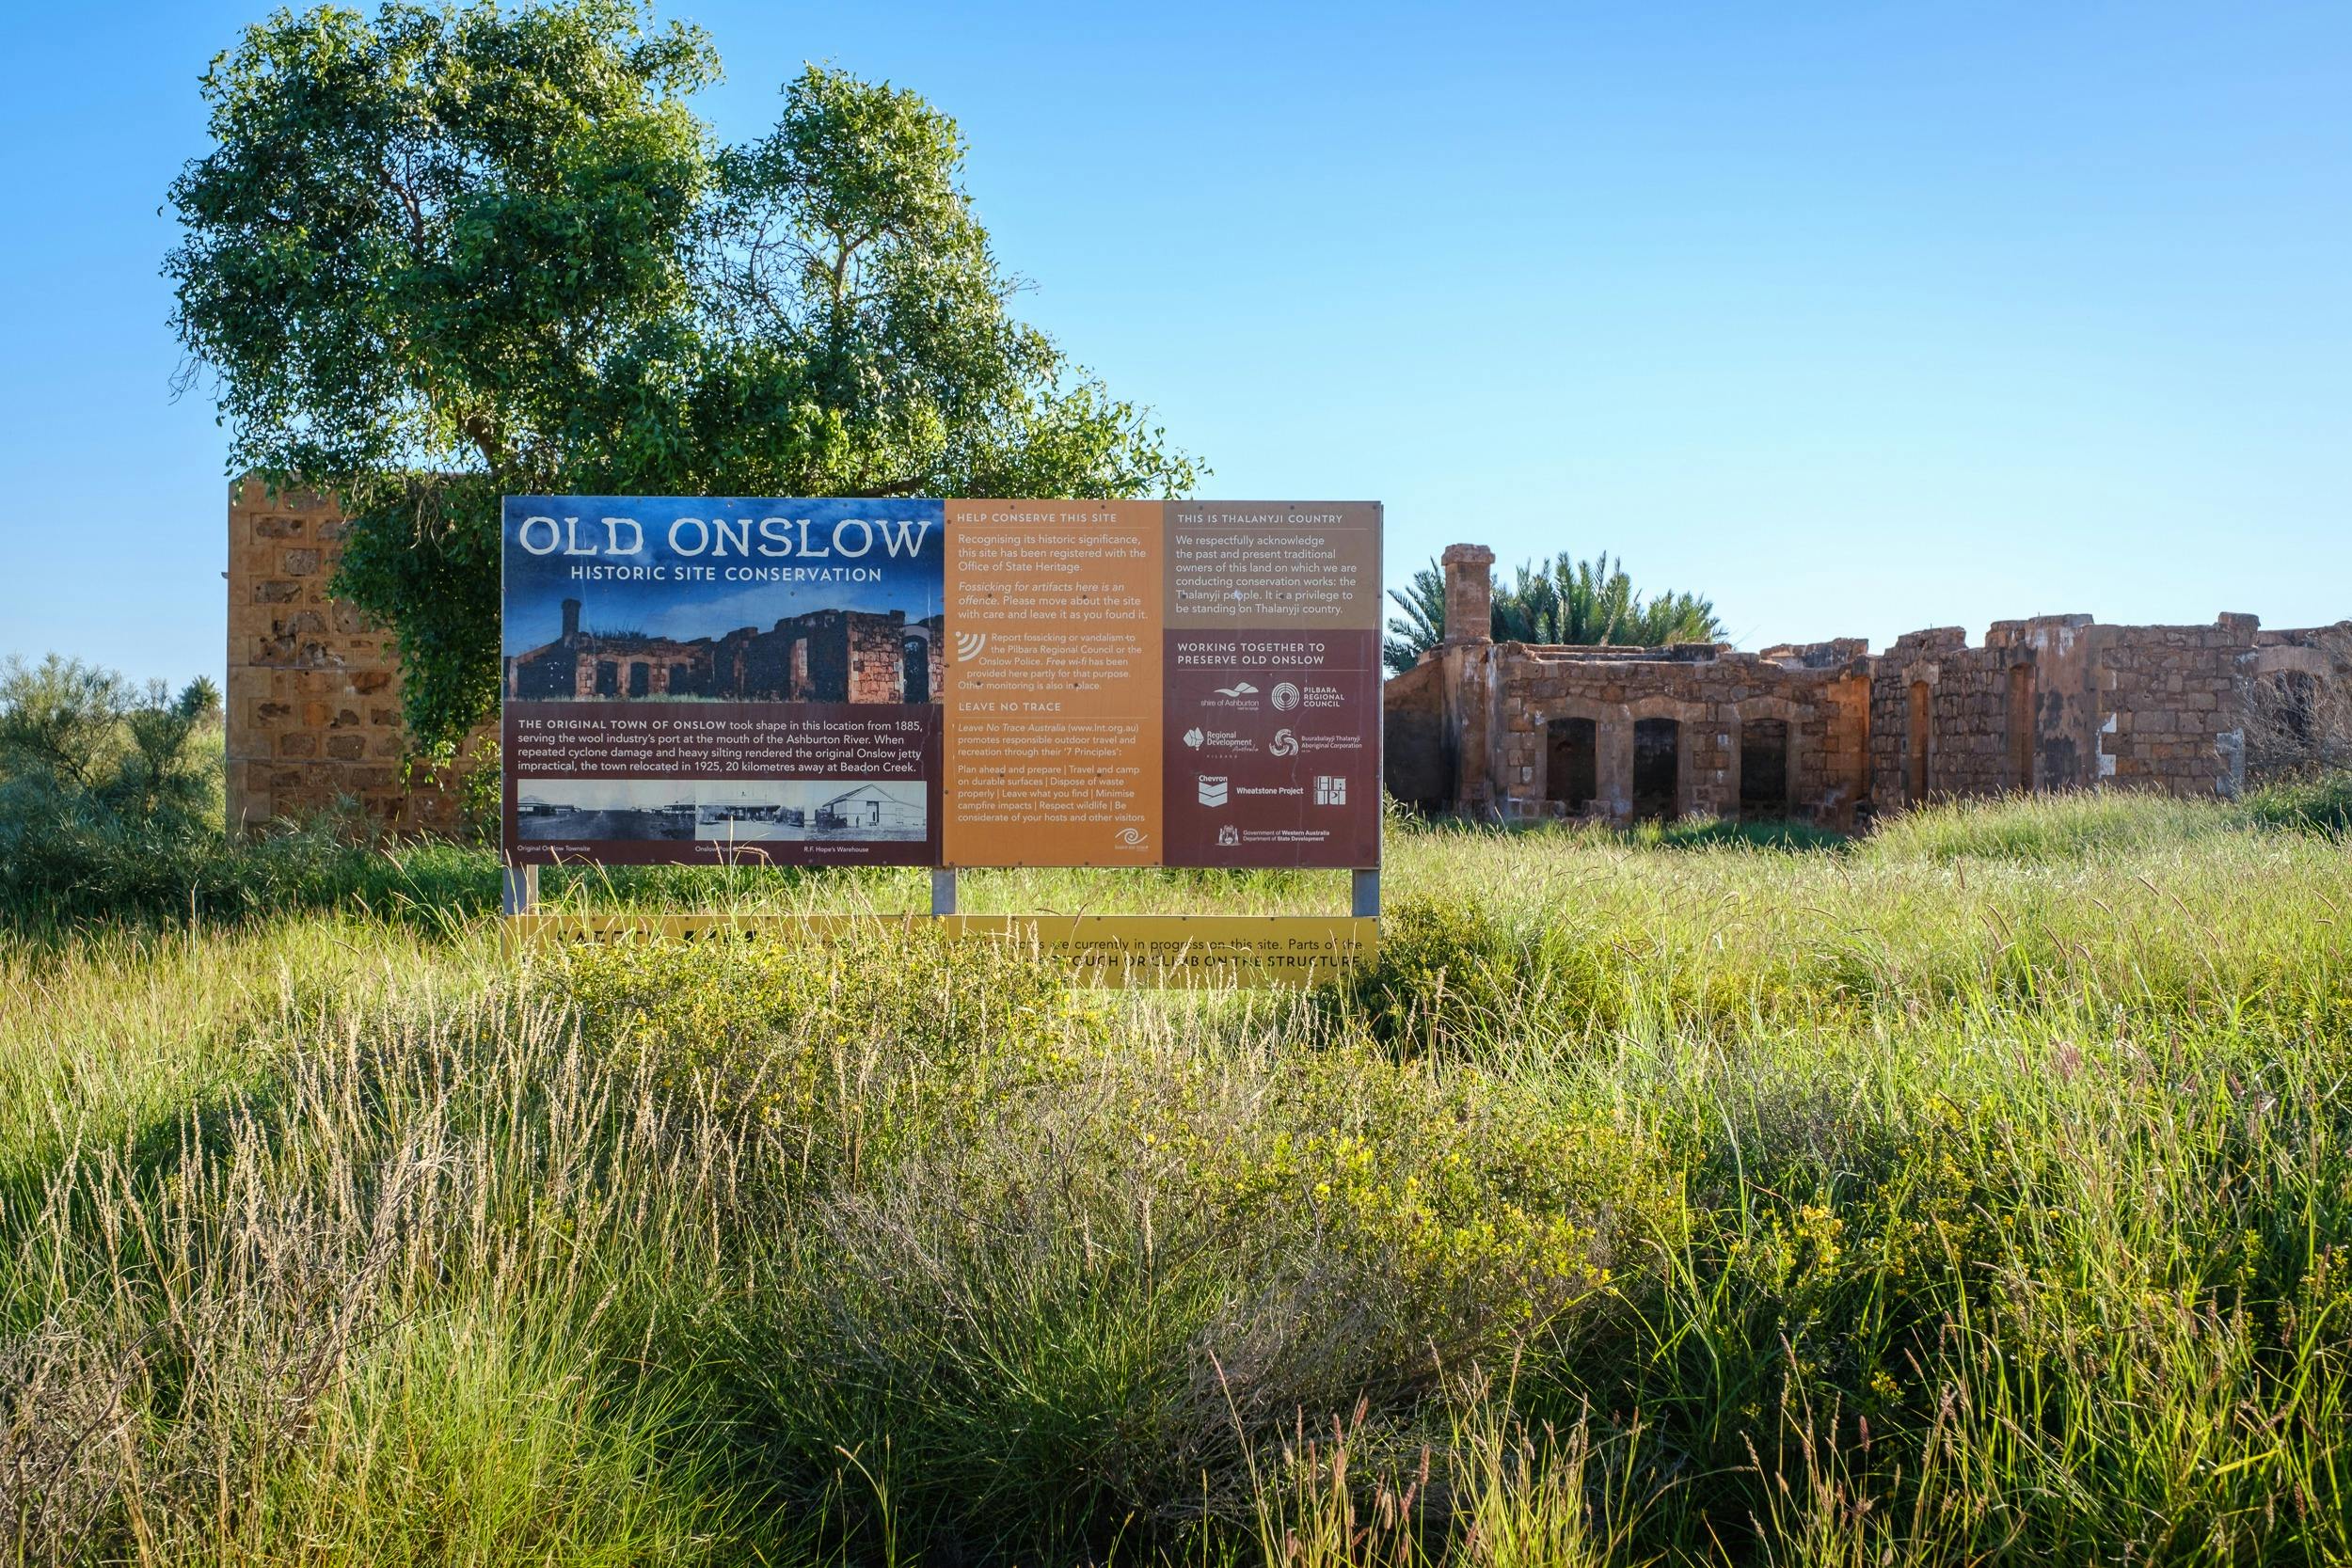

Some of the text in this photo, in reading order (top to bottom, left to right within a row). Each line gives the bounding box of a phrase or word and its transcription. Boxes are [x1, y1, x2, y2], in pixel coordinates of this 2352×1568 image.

[957, 513, 1116, 522] HELP CONSERVE THIS SITE
[520, 517, 932, 558] OLD ONSLOW
[959, 534, 1140, 546] Recognising its historic significance,
[1176, 535, 1324, 547] We respectfully acknowledge
[959, 548, 1146, 560] this site has been registered with the
[1176, 549, 1335, 561] the past and present traditional
[1216, 562, 1226, 572] of
[1229, 563, 1247, 572] this
[1250, 563, 1271, 572] land
[1291, 562, 1319, 572] which
[572, 566, 880, 581] HISTORIC SITE CONSERVATION
[1176, 576, 1356, 588] conducting conservation works: the
[1178, 643, 1325, 652] WORKING TOGETHER TO
[1178, 656, 1324, 664] PRESERVE OLD ONSLOW
[1001, 703, 1018, 711] NO
[1023, 703, 1060, 711] TRACE
[547, 720, 606, 729] ORIGINAL
[610, 721, 646, 729] TOWN
[652, 721, 668, 729] OF
[673, 721, 726, 729] ONSLOW
[730, 720, 753, 729] took
[756, 720, 786, 732] shape
[790, 721, 799, 729] in
[803, 720, 820, 730] this
[824, 721, 864, 730] location
[867, 720, 891, 730] from
[895, 721, 922, 732] 1885,
[518, 733, 555, 745] serving
[559, 733, 575, 742] the
[578, 733, 603, 743] wool
[658, 735, 680, 745] port
[697, 734, 713, 743] the
[717, 734, 749, 743] mouth
[753, 733, 764, 743] of
[766, 734, 783, 744] the
[786, 734, 840, 744] Ashburton
[844, 734, 870, 744] River.
[874, 734, 904, 744] When
[1002, 736, 1052, 745] responsible
[1093, 736, 1117, 744] travel
[1207, 731, 1236, 740] Regional
[518, 746, 921, 760] repeated cyclone damage and heavy silting rendered the original Onslow jetty
[518, 760, 577, 772] impractical,
[581, 761, 598, 770] the
[630, 761, 678, 771] relocated
[682, 762, 690, 770] in
[695, 762, 722, 772] 1925,
[726, 762, 739, 771] 20
[742, 761, 795, 771] kilometres
[798, 764, 824, 774] away
[841, 762, 879, 772] Beadon
[883, 762, 916, 772] Creek.
[1075, 938, 1128, 950] currently
[1135, 939, 1144, 949] in
[1231, 939, 1252, 949] this
[1257, 939, 1282, 949] site.
[1289, 939, 1319, 949] Parts
